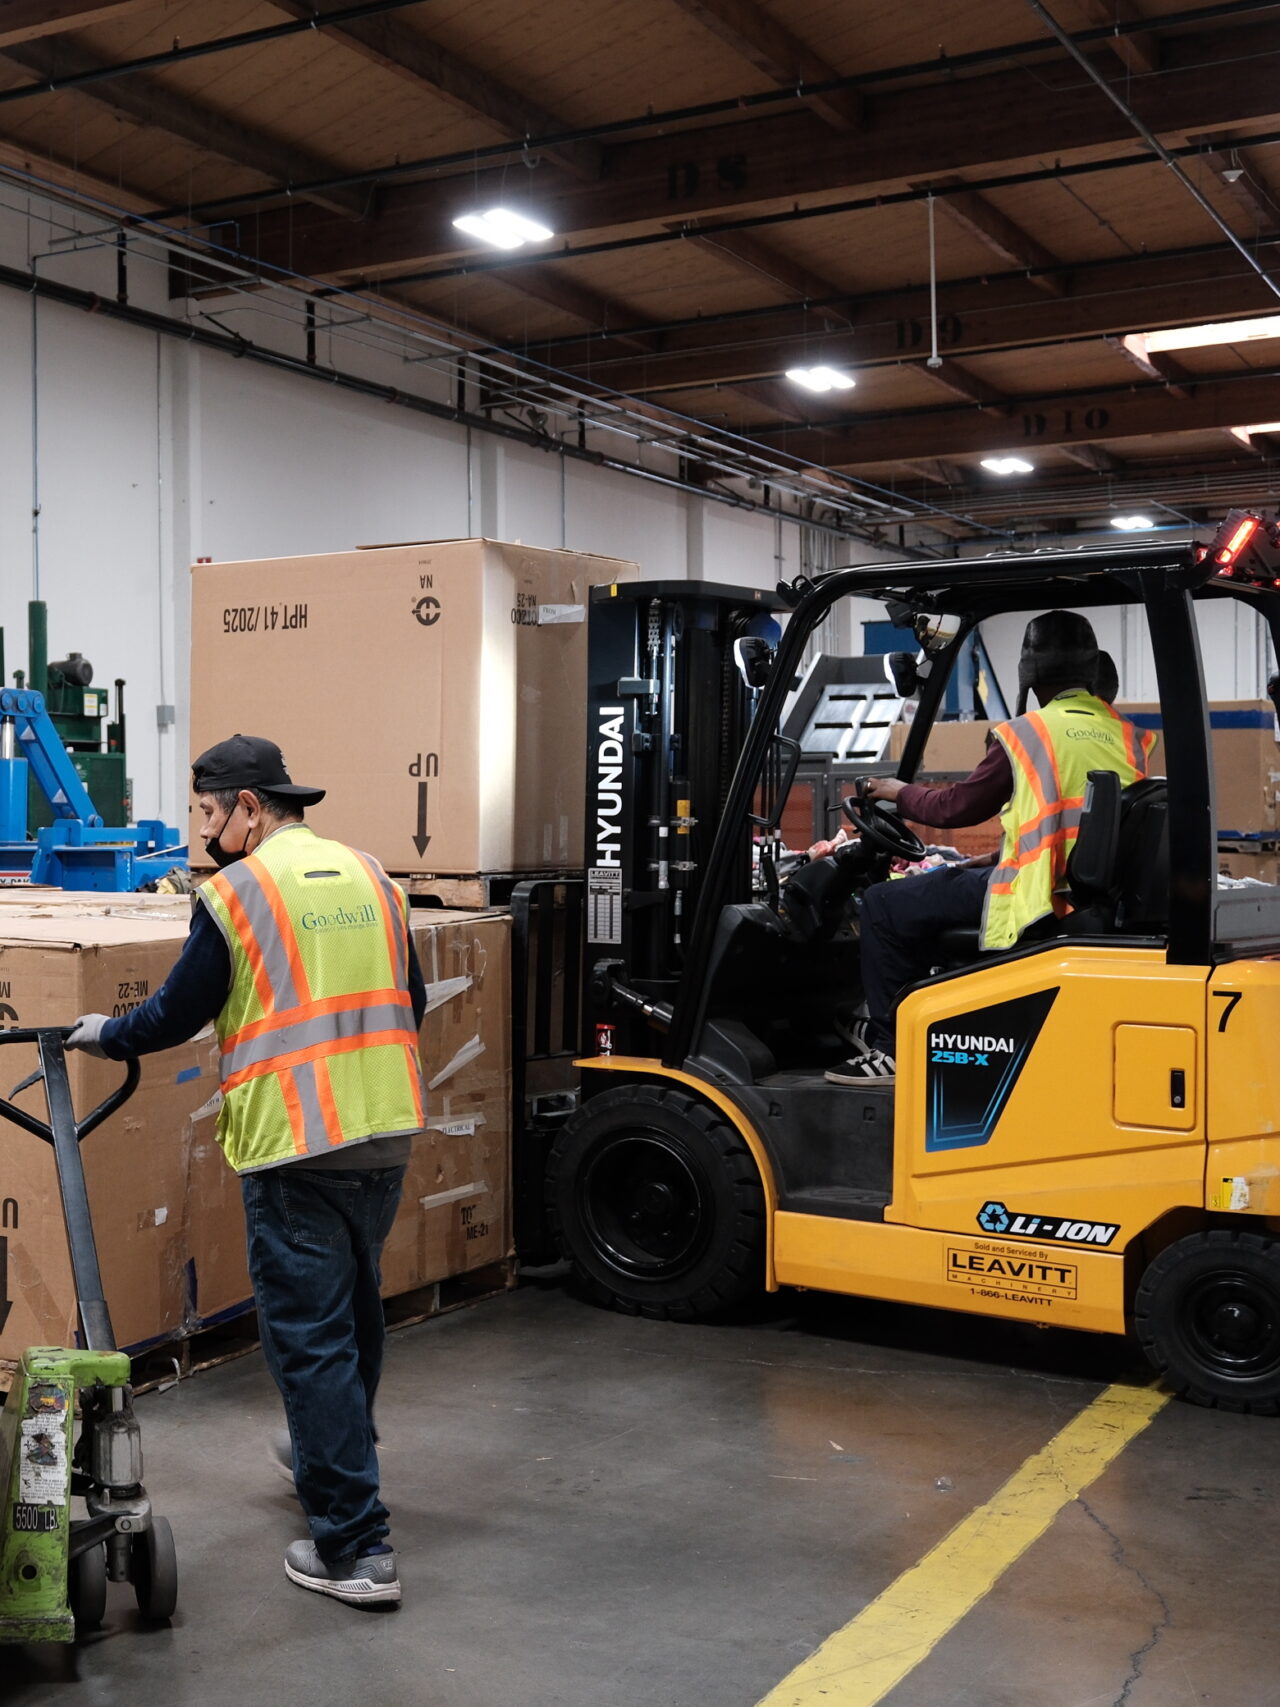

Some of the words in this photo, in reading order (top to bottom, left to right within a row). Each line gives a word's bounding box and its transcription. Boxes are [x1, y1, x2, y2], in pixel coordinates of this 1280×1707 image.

[420, 575, 433, 589] NA
[282, 603, 307, 629] HPT
[408, 753, 438, 777] UP
[596, 706, 624, 867] HYUNDAI
[302, 904, 376, 930] Goodwill
[118, 980, 148, 999] ME-22
[1212, 990, 1242, 1033] 7
[931, 1033, 1014, 1053] HYUNDAI
[931, 1050, 989, 1066] 25B-X
[974, 1242, 990, 1251] Sold
[992, 1245, 1005, 1253] and
[1006, 1247, 1037, 1257] Serviced
[1039, 1251, 1048, 1260] By
[952, 1253, 1072, 1283] LEAVITT
[970, 1288, 1053, 1306] 1-866-LEAVITT
[16, 1506, 38, 1529] 5500
